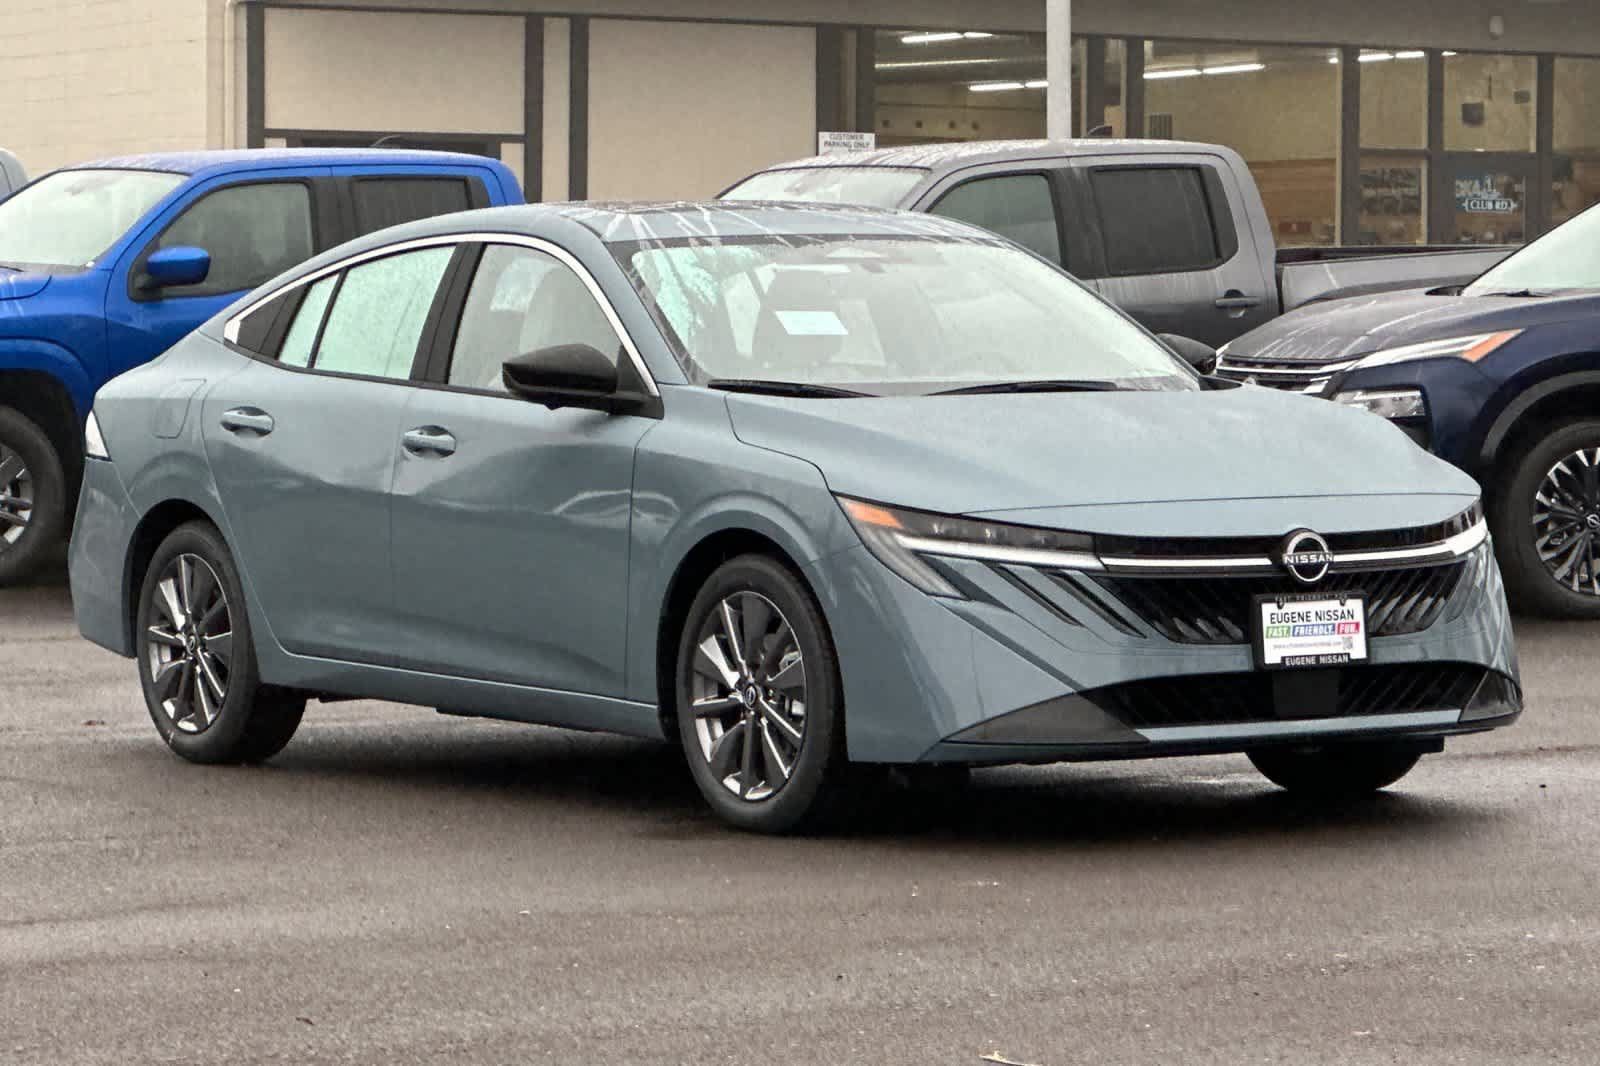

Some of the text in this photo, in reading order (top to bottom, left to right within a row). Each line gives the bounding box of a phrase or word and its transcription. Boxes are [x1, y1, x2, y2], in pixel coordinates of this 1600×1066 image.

[1284, 553, 1334, 564] NISSAN
[1270, 608, 1354, 624] EUGENE NISSAN
[1294, 625, 1334, 636] FRIENDLY.
[1285, 654, 1349, 666] EUGENE NISSAN
